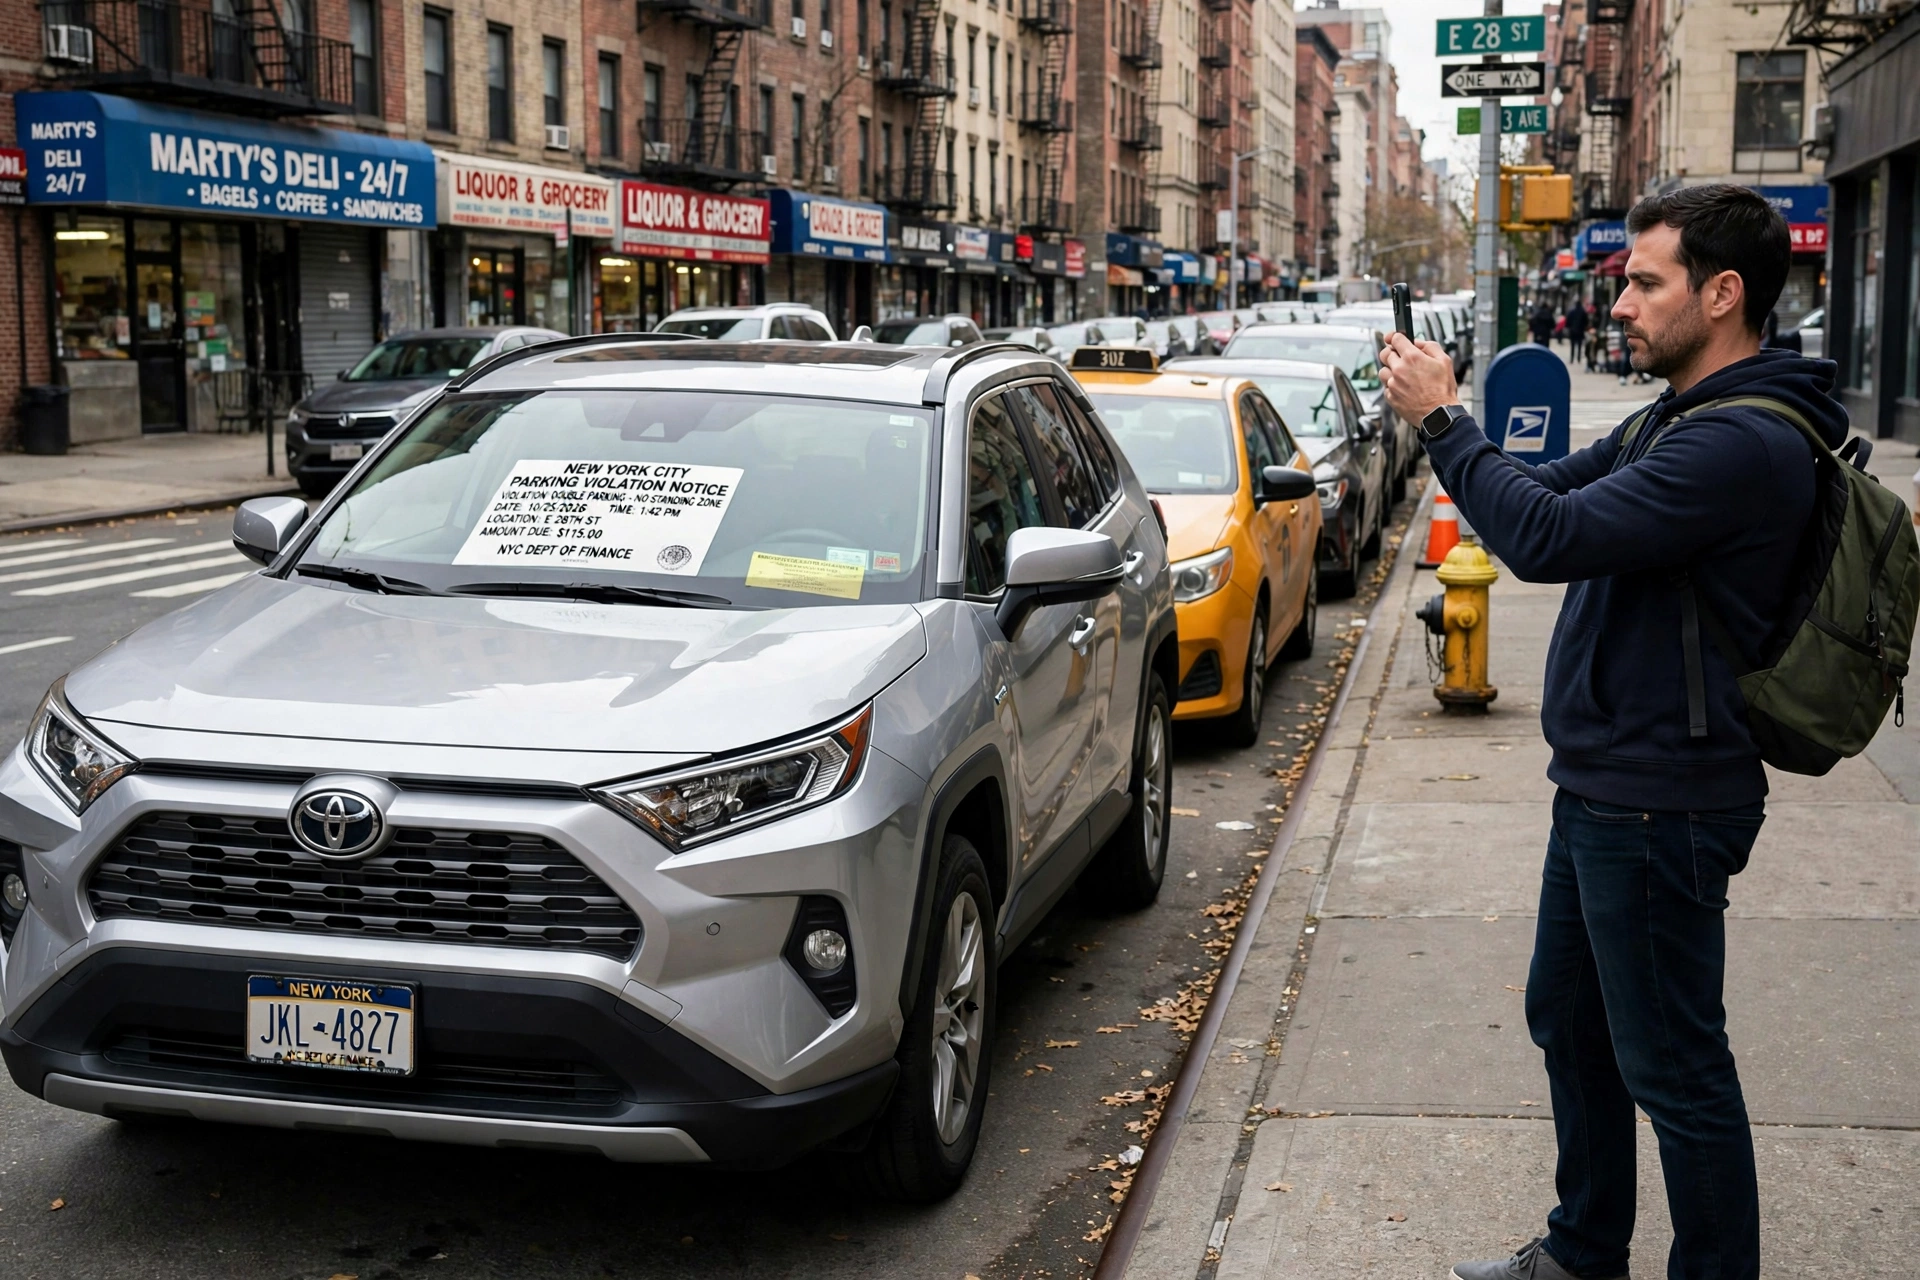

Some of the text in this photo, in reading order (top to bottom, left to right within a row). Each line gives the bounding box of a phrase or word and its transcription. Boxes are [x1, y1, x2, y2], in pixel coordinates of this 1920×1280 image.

[1449, 22, 1531, 51] E 28 ST
[1454, 72, 1532, 88] ONE WAY
[31, 120, 97, 139] MARTY'S
[1503, 109, 1542, 131] 3 AVE
[44, 149, 82, 168] DELI
[150, 132, 278, 184] MARTY'S
[284, 150, 340, 190] DELI
[359, 159, 409, 199] 24/7
[46, 170, 86, 195] 24/7
[456, 170, 609, 211] LIQUOR & GROCERY
[200, 182, 259, 209] BAGELS
[275, 190, 328, 215] COFFEE
[343, 197, 424, 224] SANDWICHES
[627, 188, 685, 229] LIQUOR
[688, 196, 700, 229] &
[702, 198, 764, 235] GROCERY
[564, 463, 691, 478] NEW YORK CITY
[510, 476, 729, 496] PARKING VIOLATION NOTICE
[587, 491, 626, 502] PARKING
[634, 494, 649, 503] NO
[652, 495, 695, 506] STANDING
[697, 498, 723, 508] ZONE
[487, 514, 602, 525] LOCATION: E 28TH ST
[663, 507, 681, 517] PM
[479, 526, 603, 539] AMOUNT DUE: $115.00
[497, 544, 633, 559] NYC DEPT OF FINANCE
[289, 982, 373, 1002] NEW YORK
